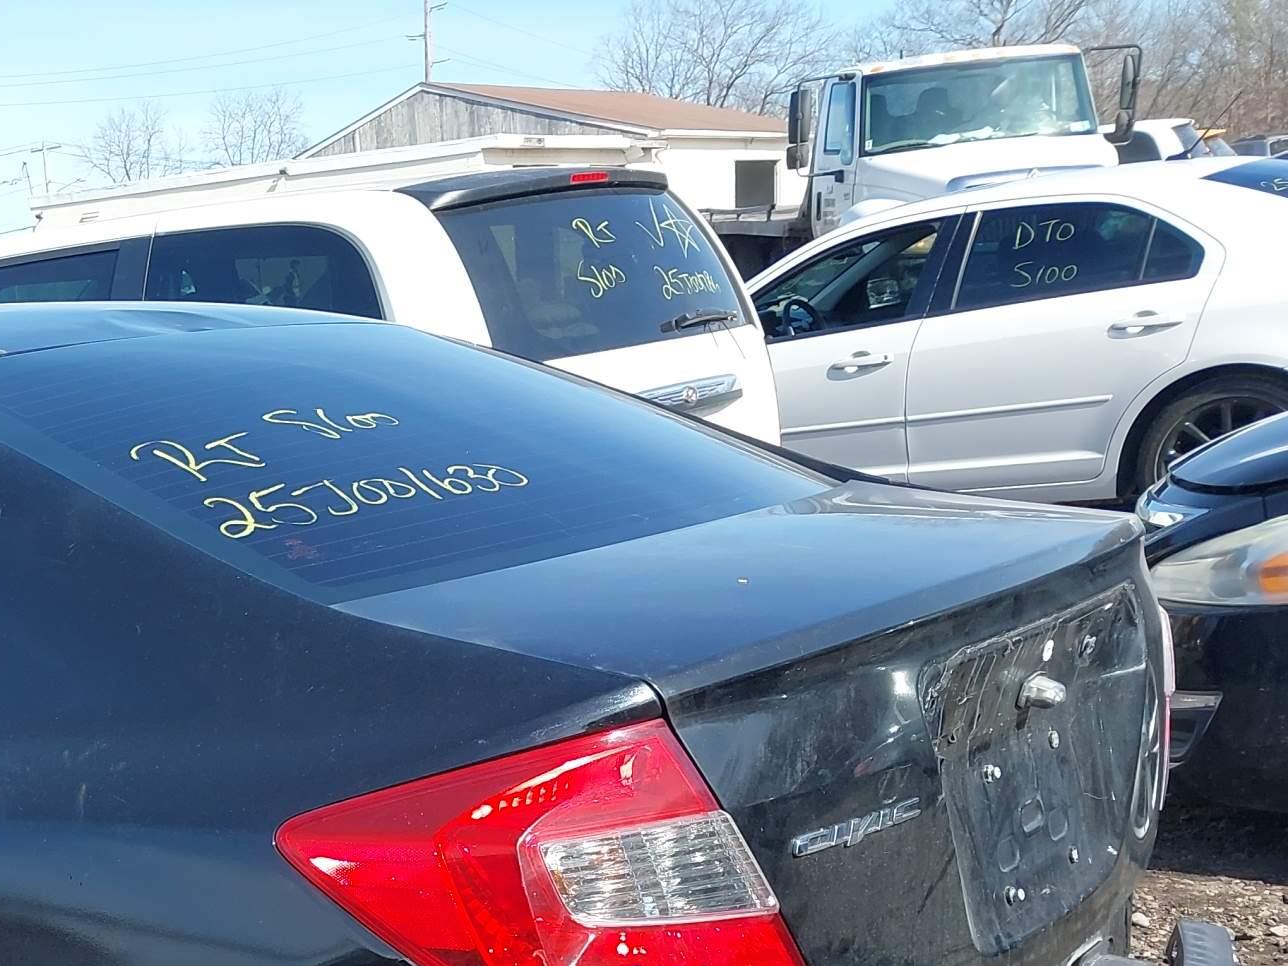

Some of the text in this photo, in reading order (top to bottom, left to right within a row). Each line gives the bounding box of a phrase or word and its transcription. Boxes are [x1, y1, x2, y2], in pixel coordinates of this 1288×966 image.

[1010, 261, 1078, 288] S100
[130, 432, 266, 482] RT
[791, 797, 922, 858] CIVIC
